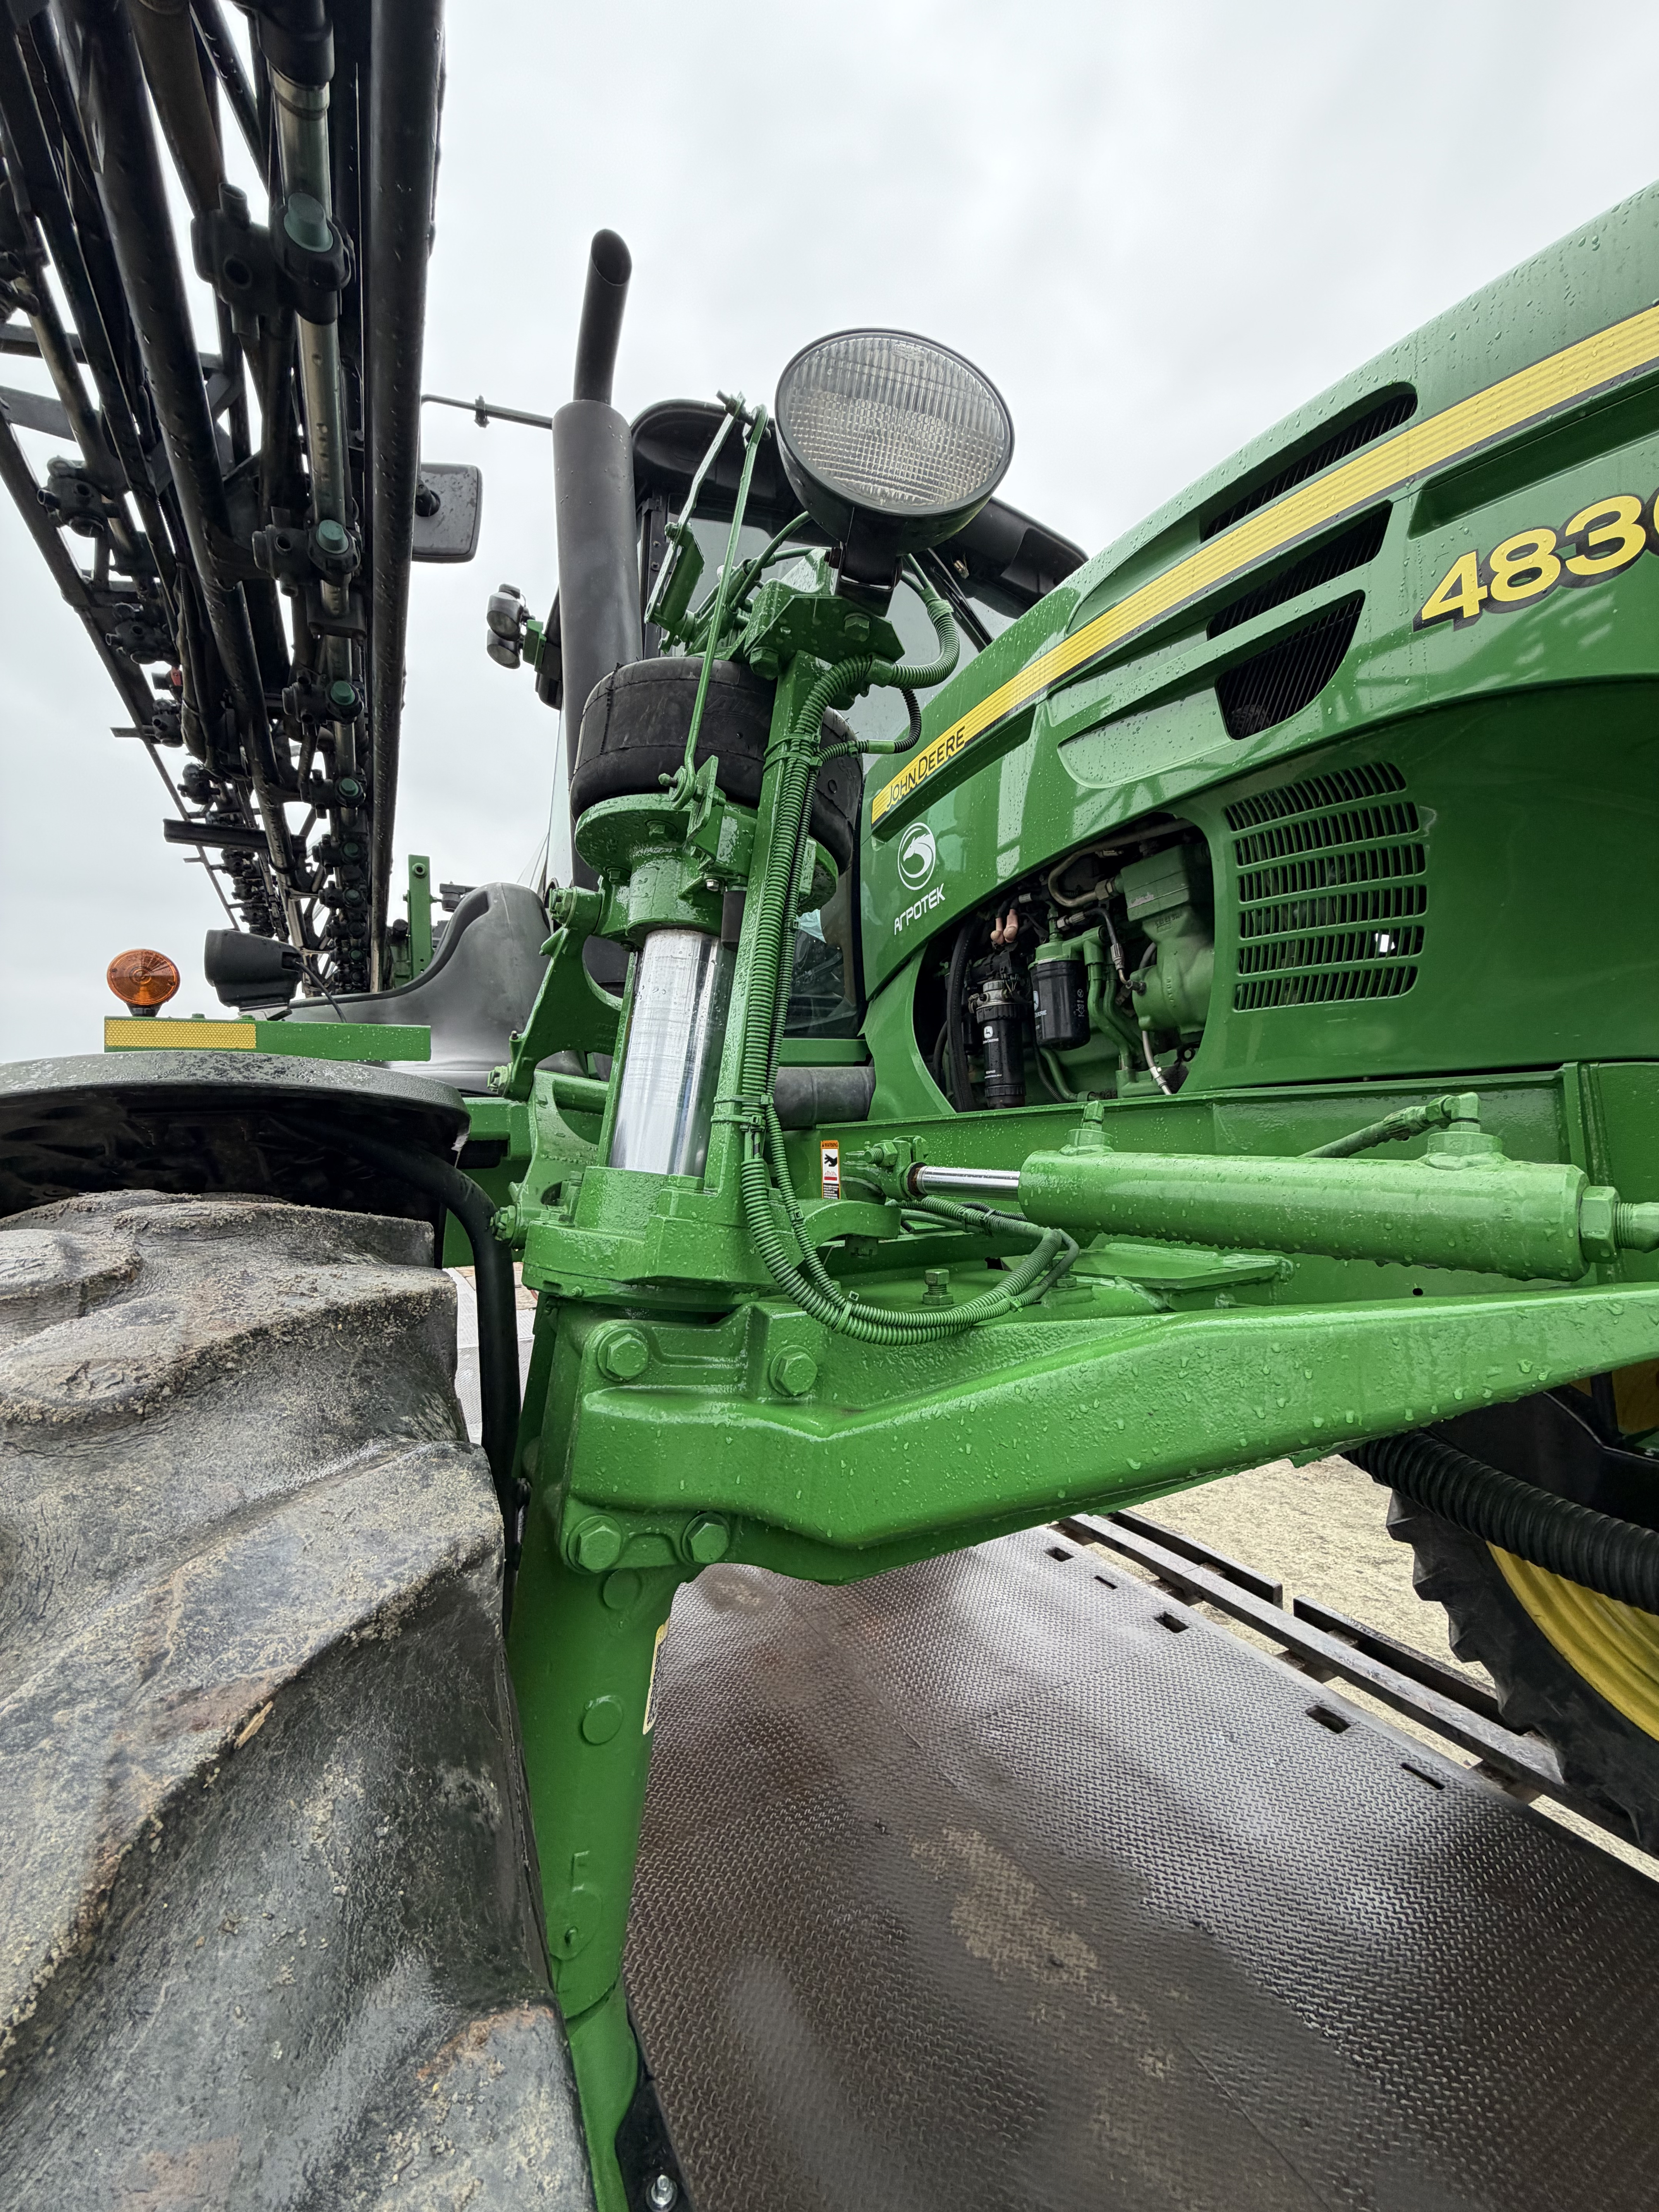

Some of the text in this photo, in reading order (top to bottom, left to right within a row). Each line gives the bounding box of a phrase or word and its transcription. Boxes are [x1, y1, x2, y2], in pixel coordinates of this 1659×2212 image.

[1413, 487, 1659, 632] 483
[886, 767, 916, 808] JOHN
[918, 725, 965, 780] DEERE
[894, 883, 946, 936] АГРОТЕК
